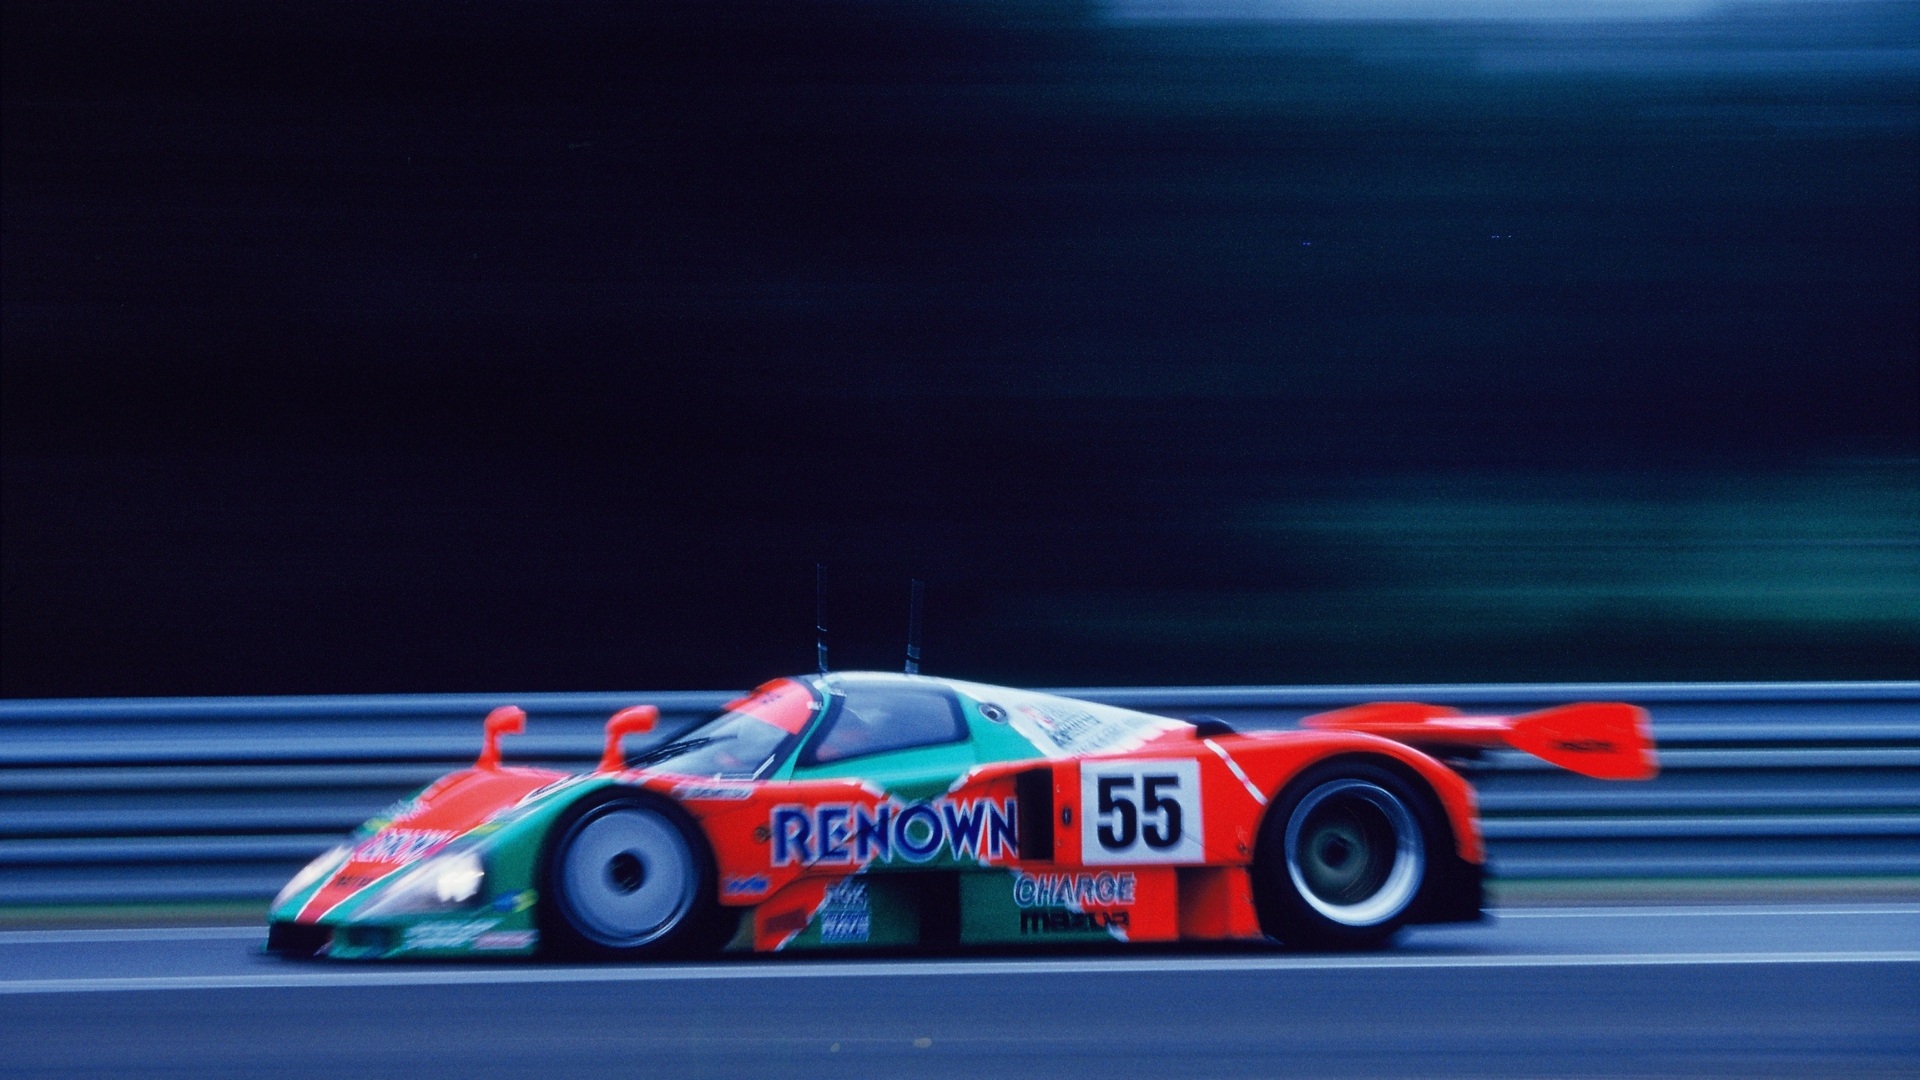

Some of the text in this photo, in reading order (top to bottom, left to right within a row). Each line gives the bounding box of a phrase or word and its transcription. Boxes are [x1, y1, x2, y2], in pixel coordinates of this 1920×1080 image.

[769, 797, 1019, 867] RENOWN
[1097, 773, 1182, 852] 55
[1013, 871, 1137, 908] CHARGE
